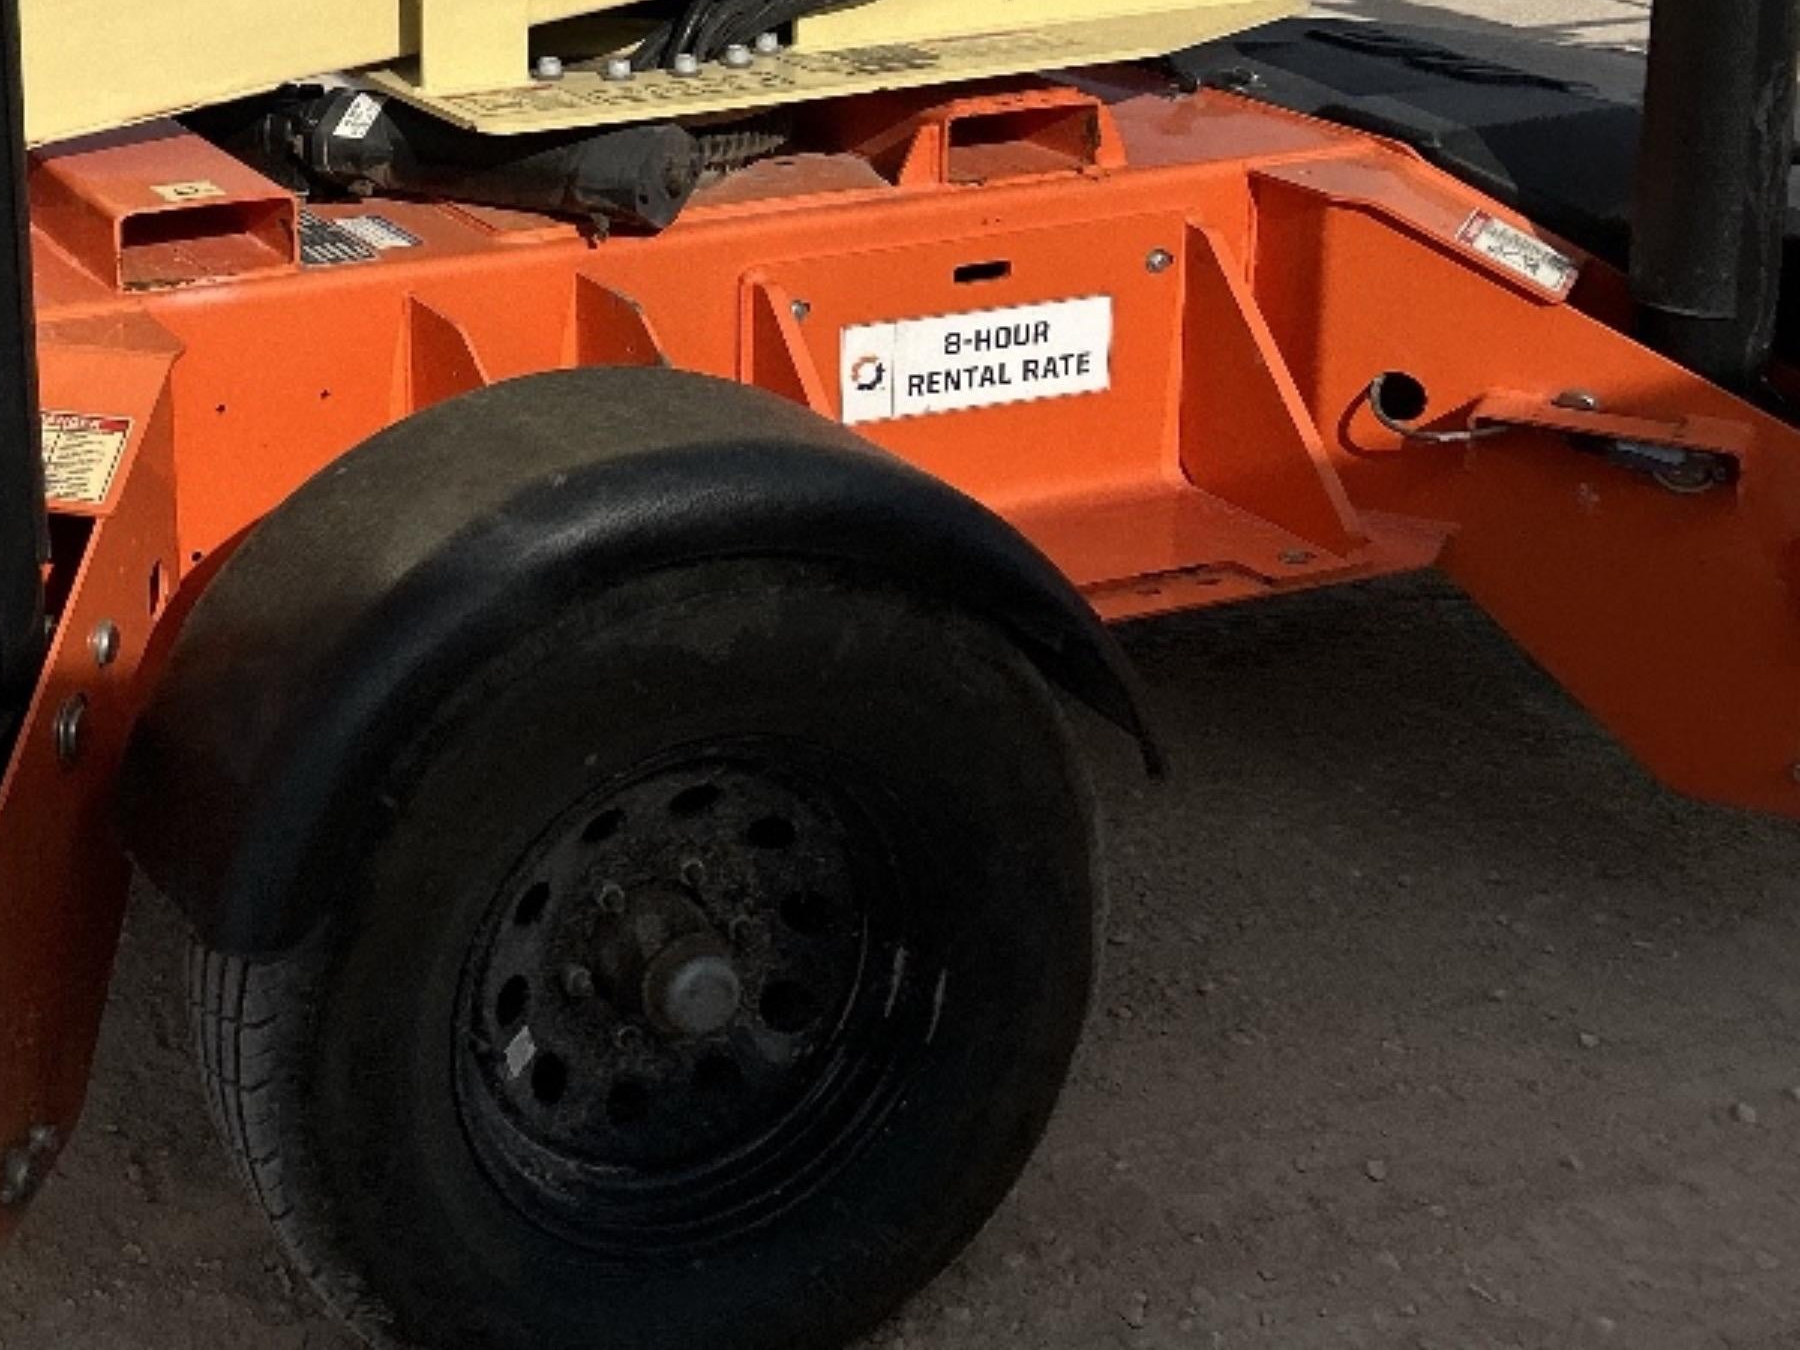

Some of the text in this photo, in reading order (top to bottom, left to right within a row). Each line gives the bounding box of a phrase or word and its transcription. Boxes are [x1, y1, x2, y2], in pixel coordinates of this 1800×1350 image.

[944, 321, 1050, 355] 8-HOUR
[908, 353, 1091, 397] RENTAL RATE
